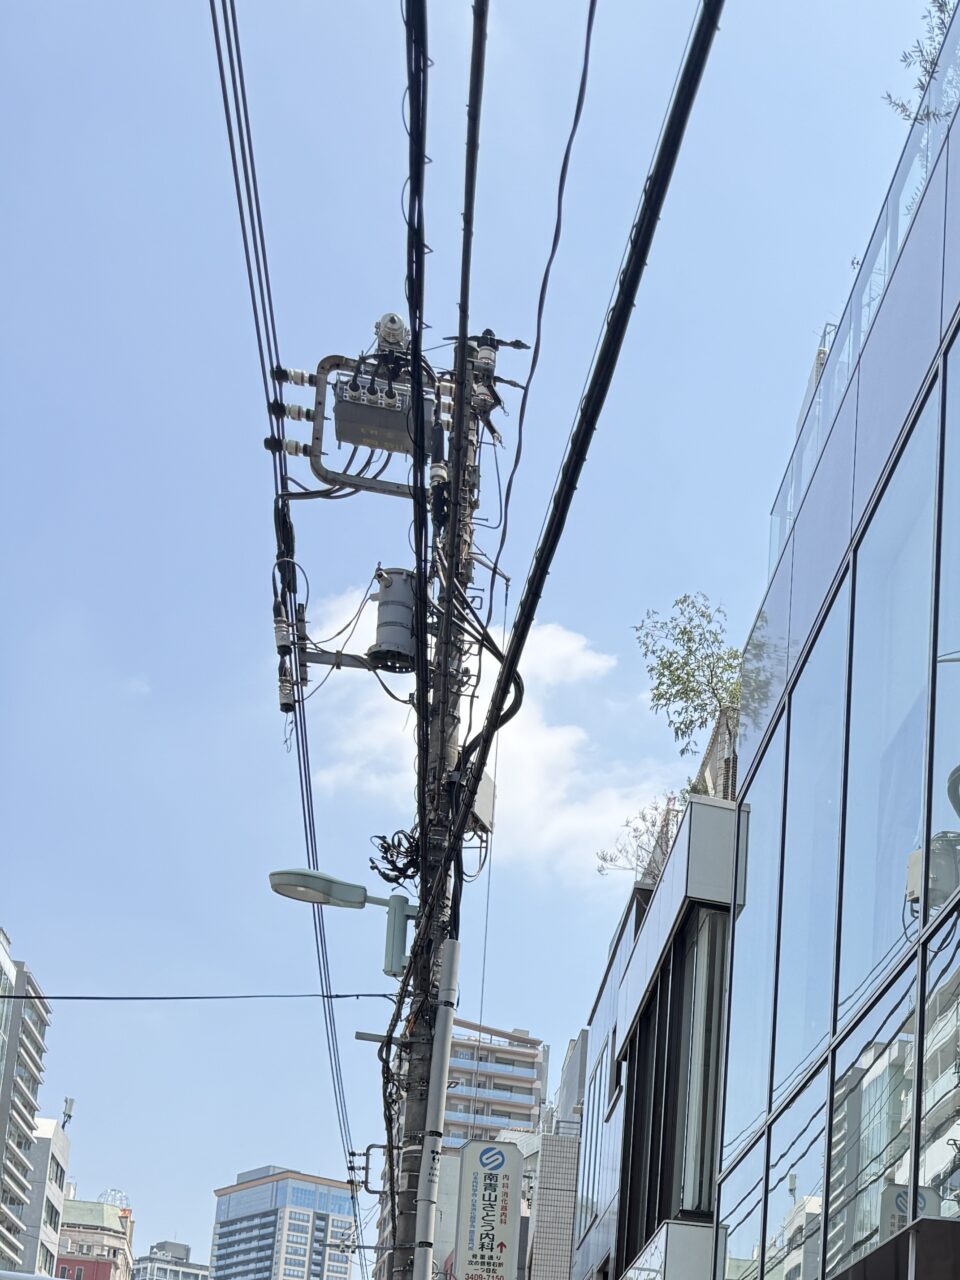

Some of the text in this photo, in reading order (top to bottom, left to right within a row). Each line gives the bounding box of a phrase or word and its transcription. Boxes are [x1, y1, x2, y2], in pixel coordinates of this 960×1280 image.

[479, 1172, 499, 1253] 南青山さとう内科
